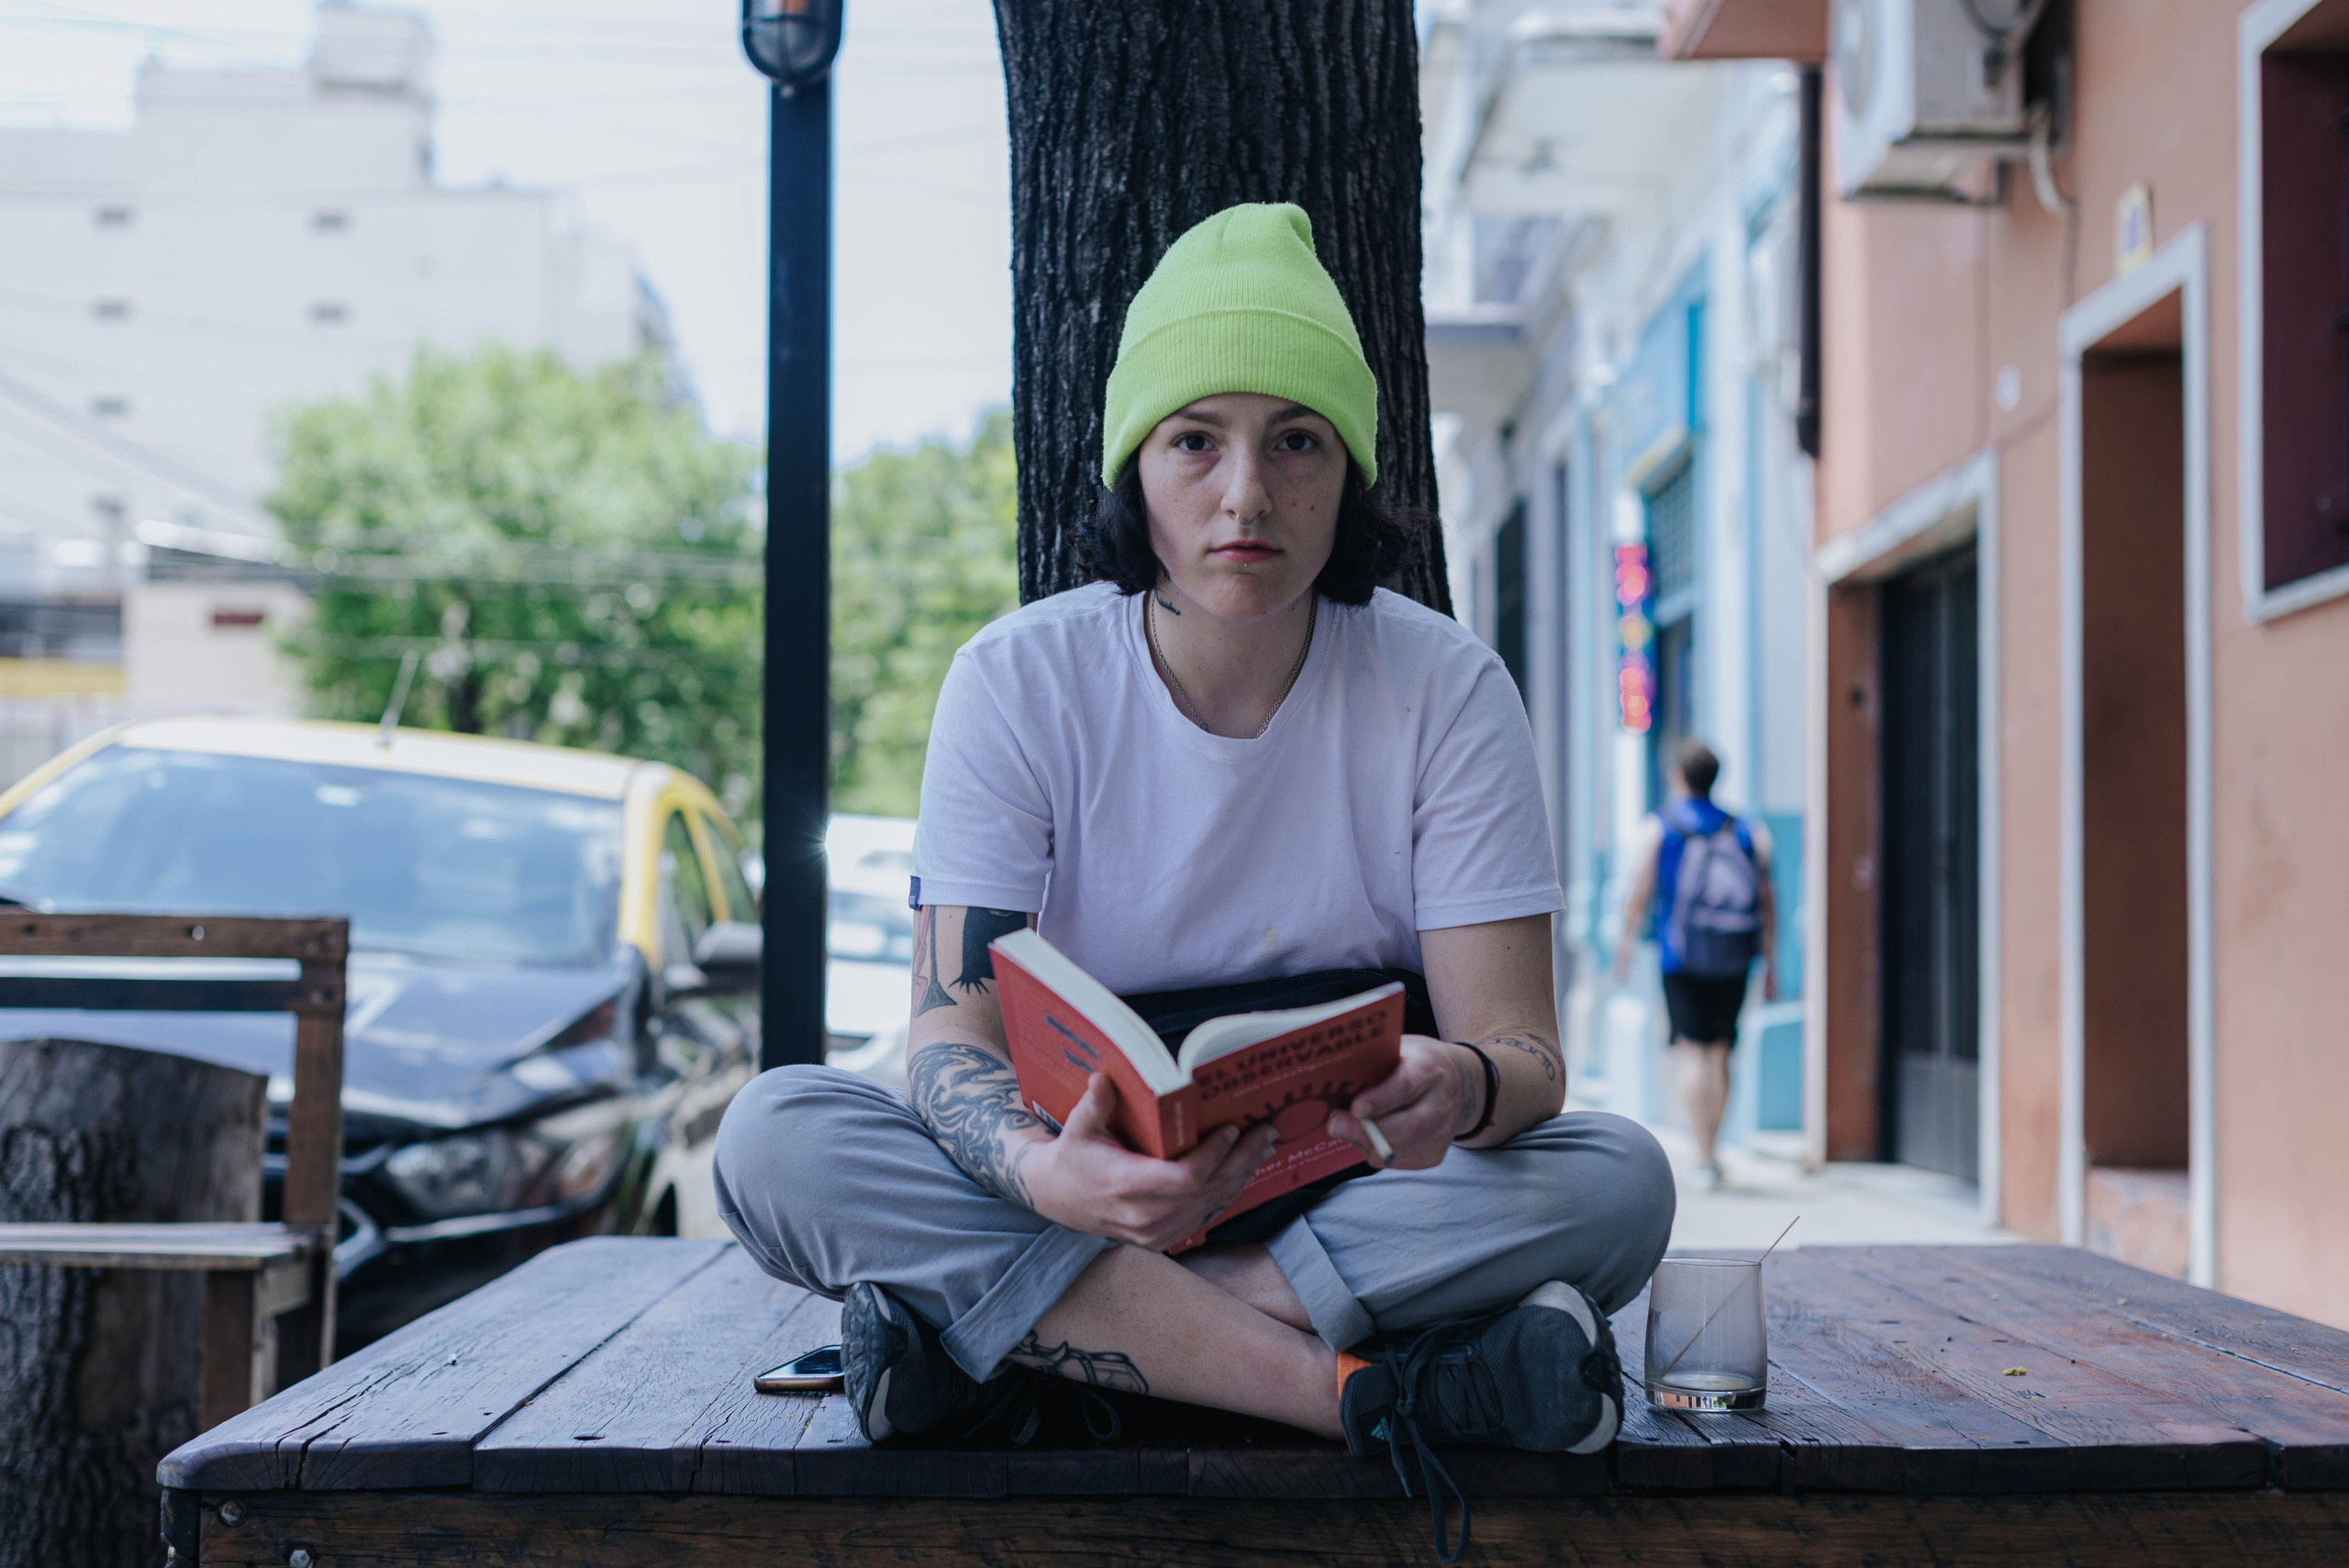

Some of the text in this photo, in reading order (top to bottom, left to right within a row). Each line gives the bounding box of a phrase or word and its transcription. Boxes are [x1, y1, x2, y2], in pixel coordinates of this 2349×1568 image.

[1198, 1010, 1387, 1087] EL UNIVERSO
[1200, 1025, 1386, 1100] OBSERVABLE
